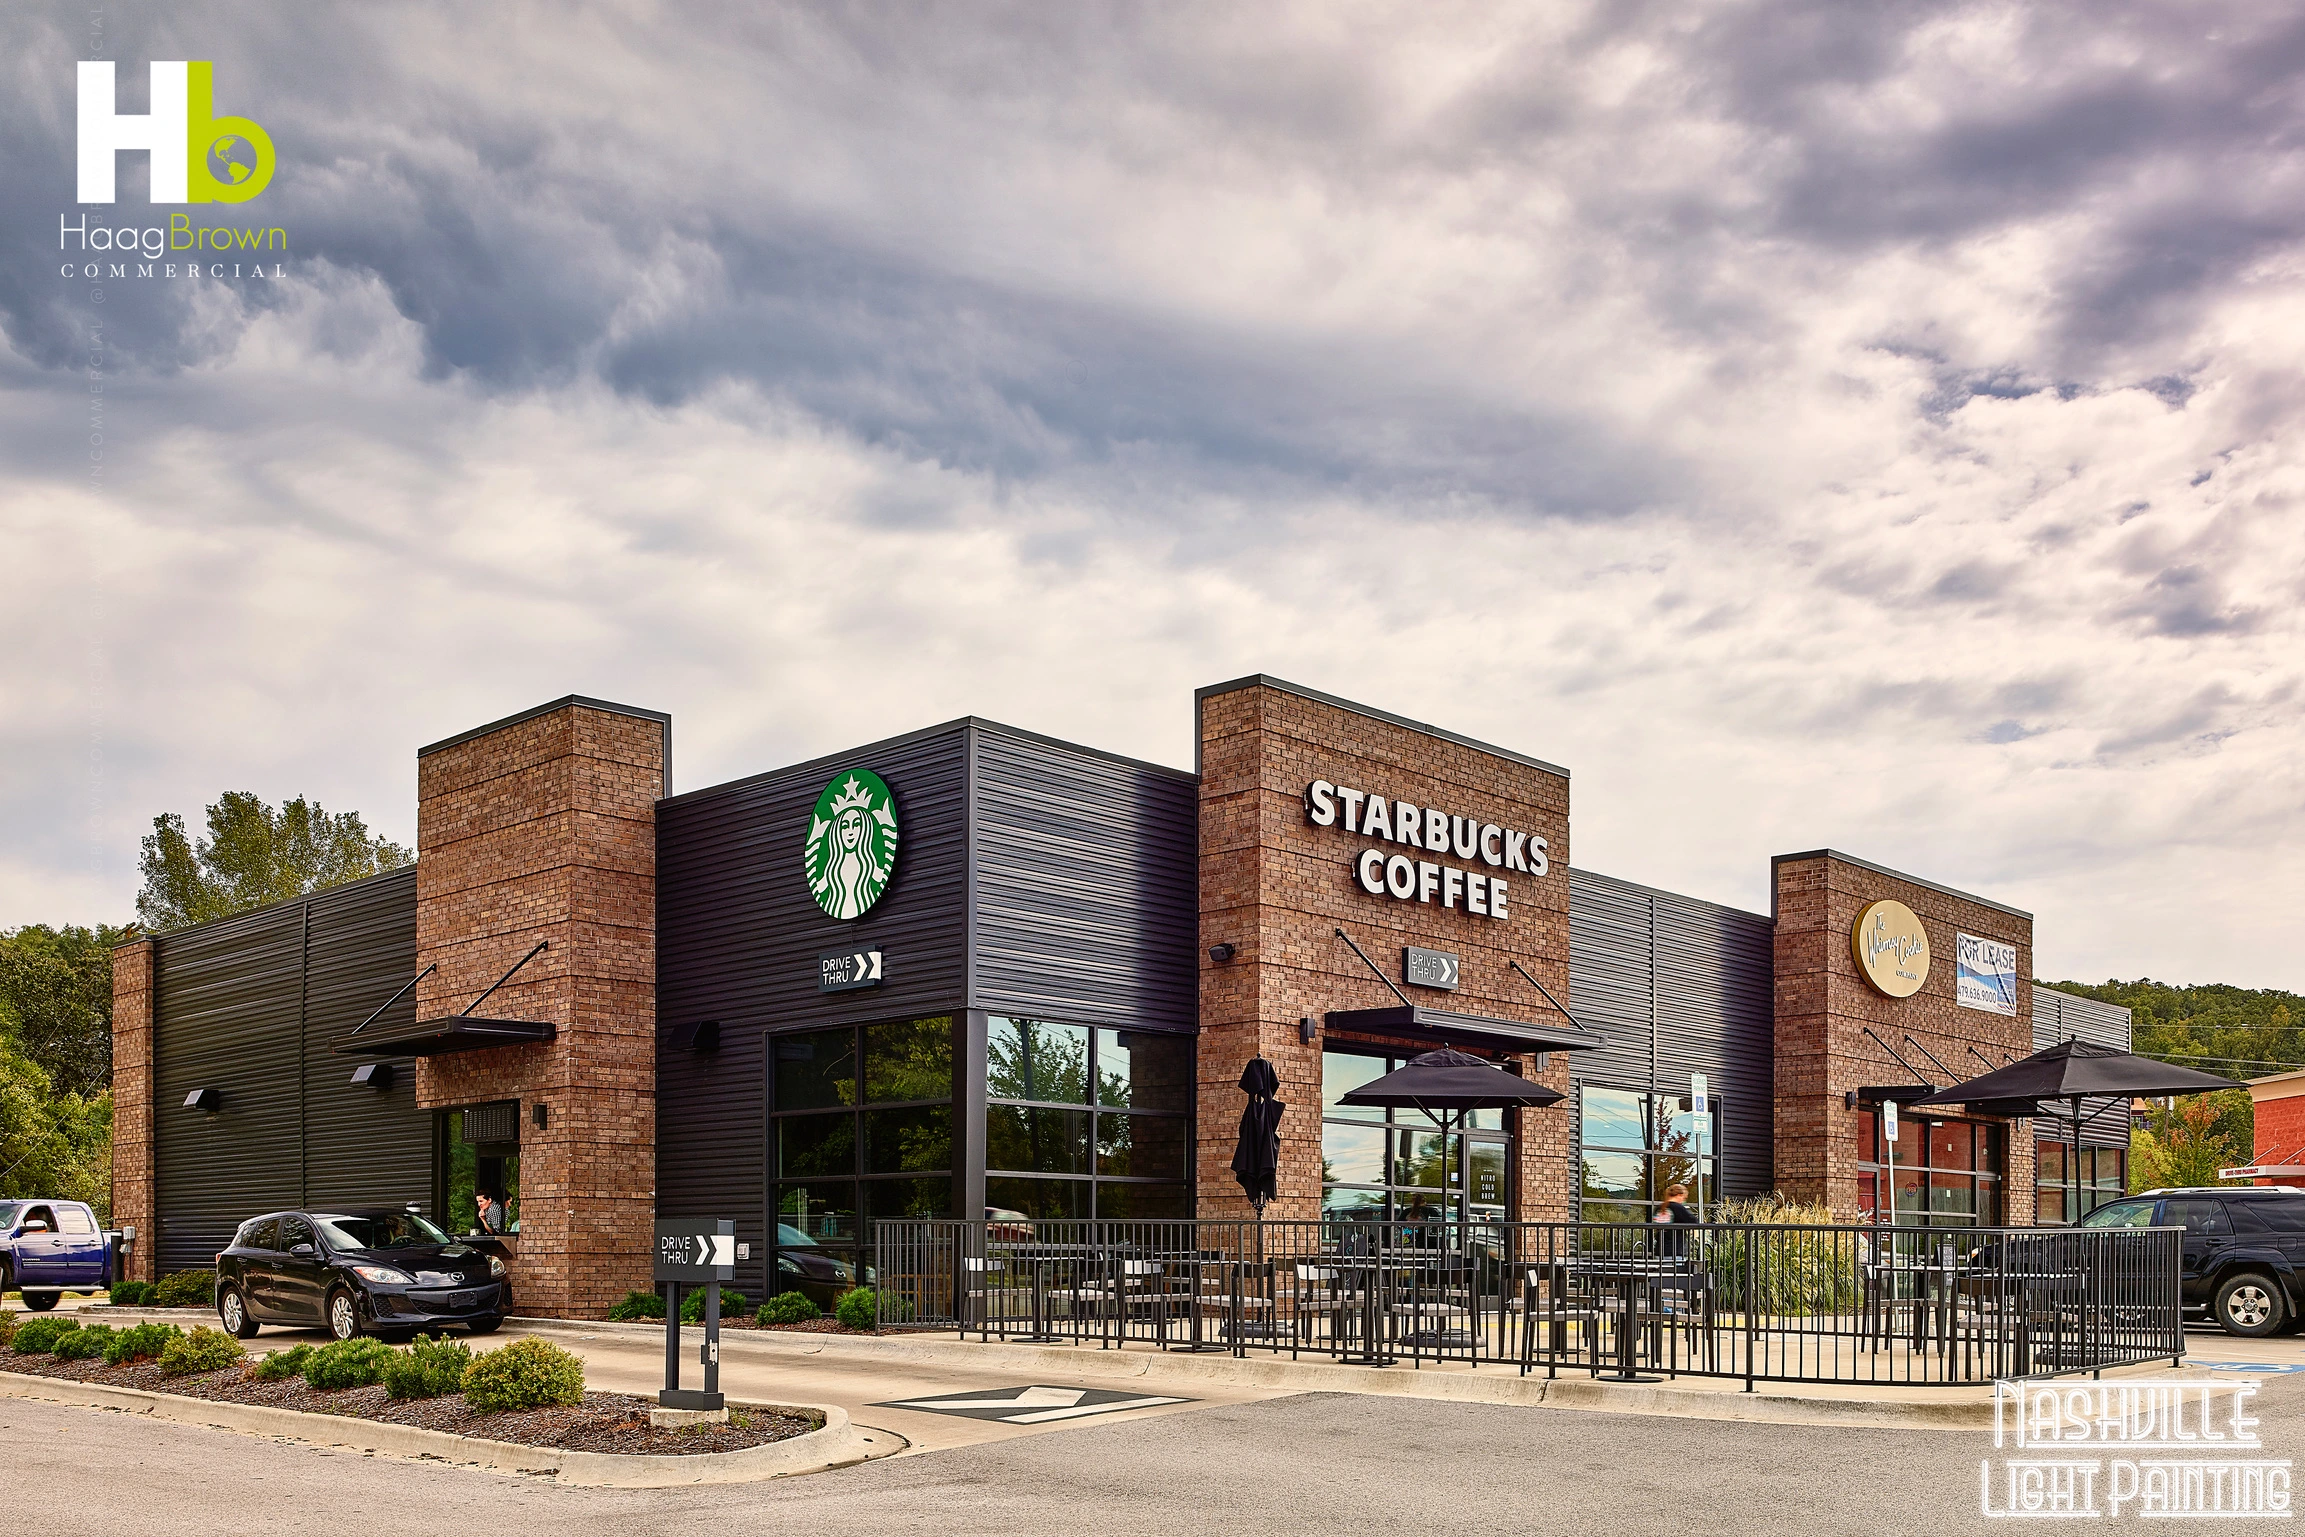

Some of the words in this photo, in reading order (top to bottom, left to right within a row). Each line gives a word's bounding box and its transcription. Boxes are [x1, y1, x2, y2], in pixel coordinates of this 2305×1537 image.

[1307, 780, 1549, 877] STARBUCKS
[1356, 849, 1509, 920] COFFEE
[1875, 912, 1885, 930] The
[1899, 933, 1924, 966] Cookie
[1958, 937, 1980, 962] FOR
[1983, 943, 2015, 971] LEASE
[822, 956, 851, 972] DRIVE
[1411, 953, 1437, 969] DRIVE
[822, 970, 850, 985] THRU
[1412, 966, 1436, 980] THRU
[1957, 984, 1998, 1004] 479.636.9000
[1481, 1183, 1495, 1191] COLD
[661, 1236, 691, 1250] DRIVE
[661, 1251, 689, 1265] THRU
